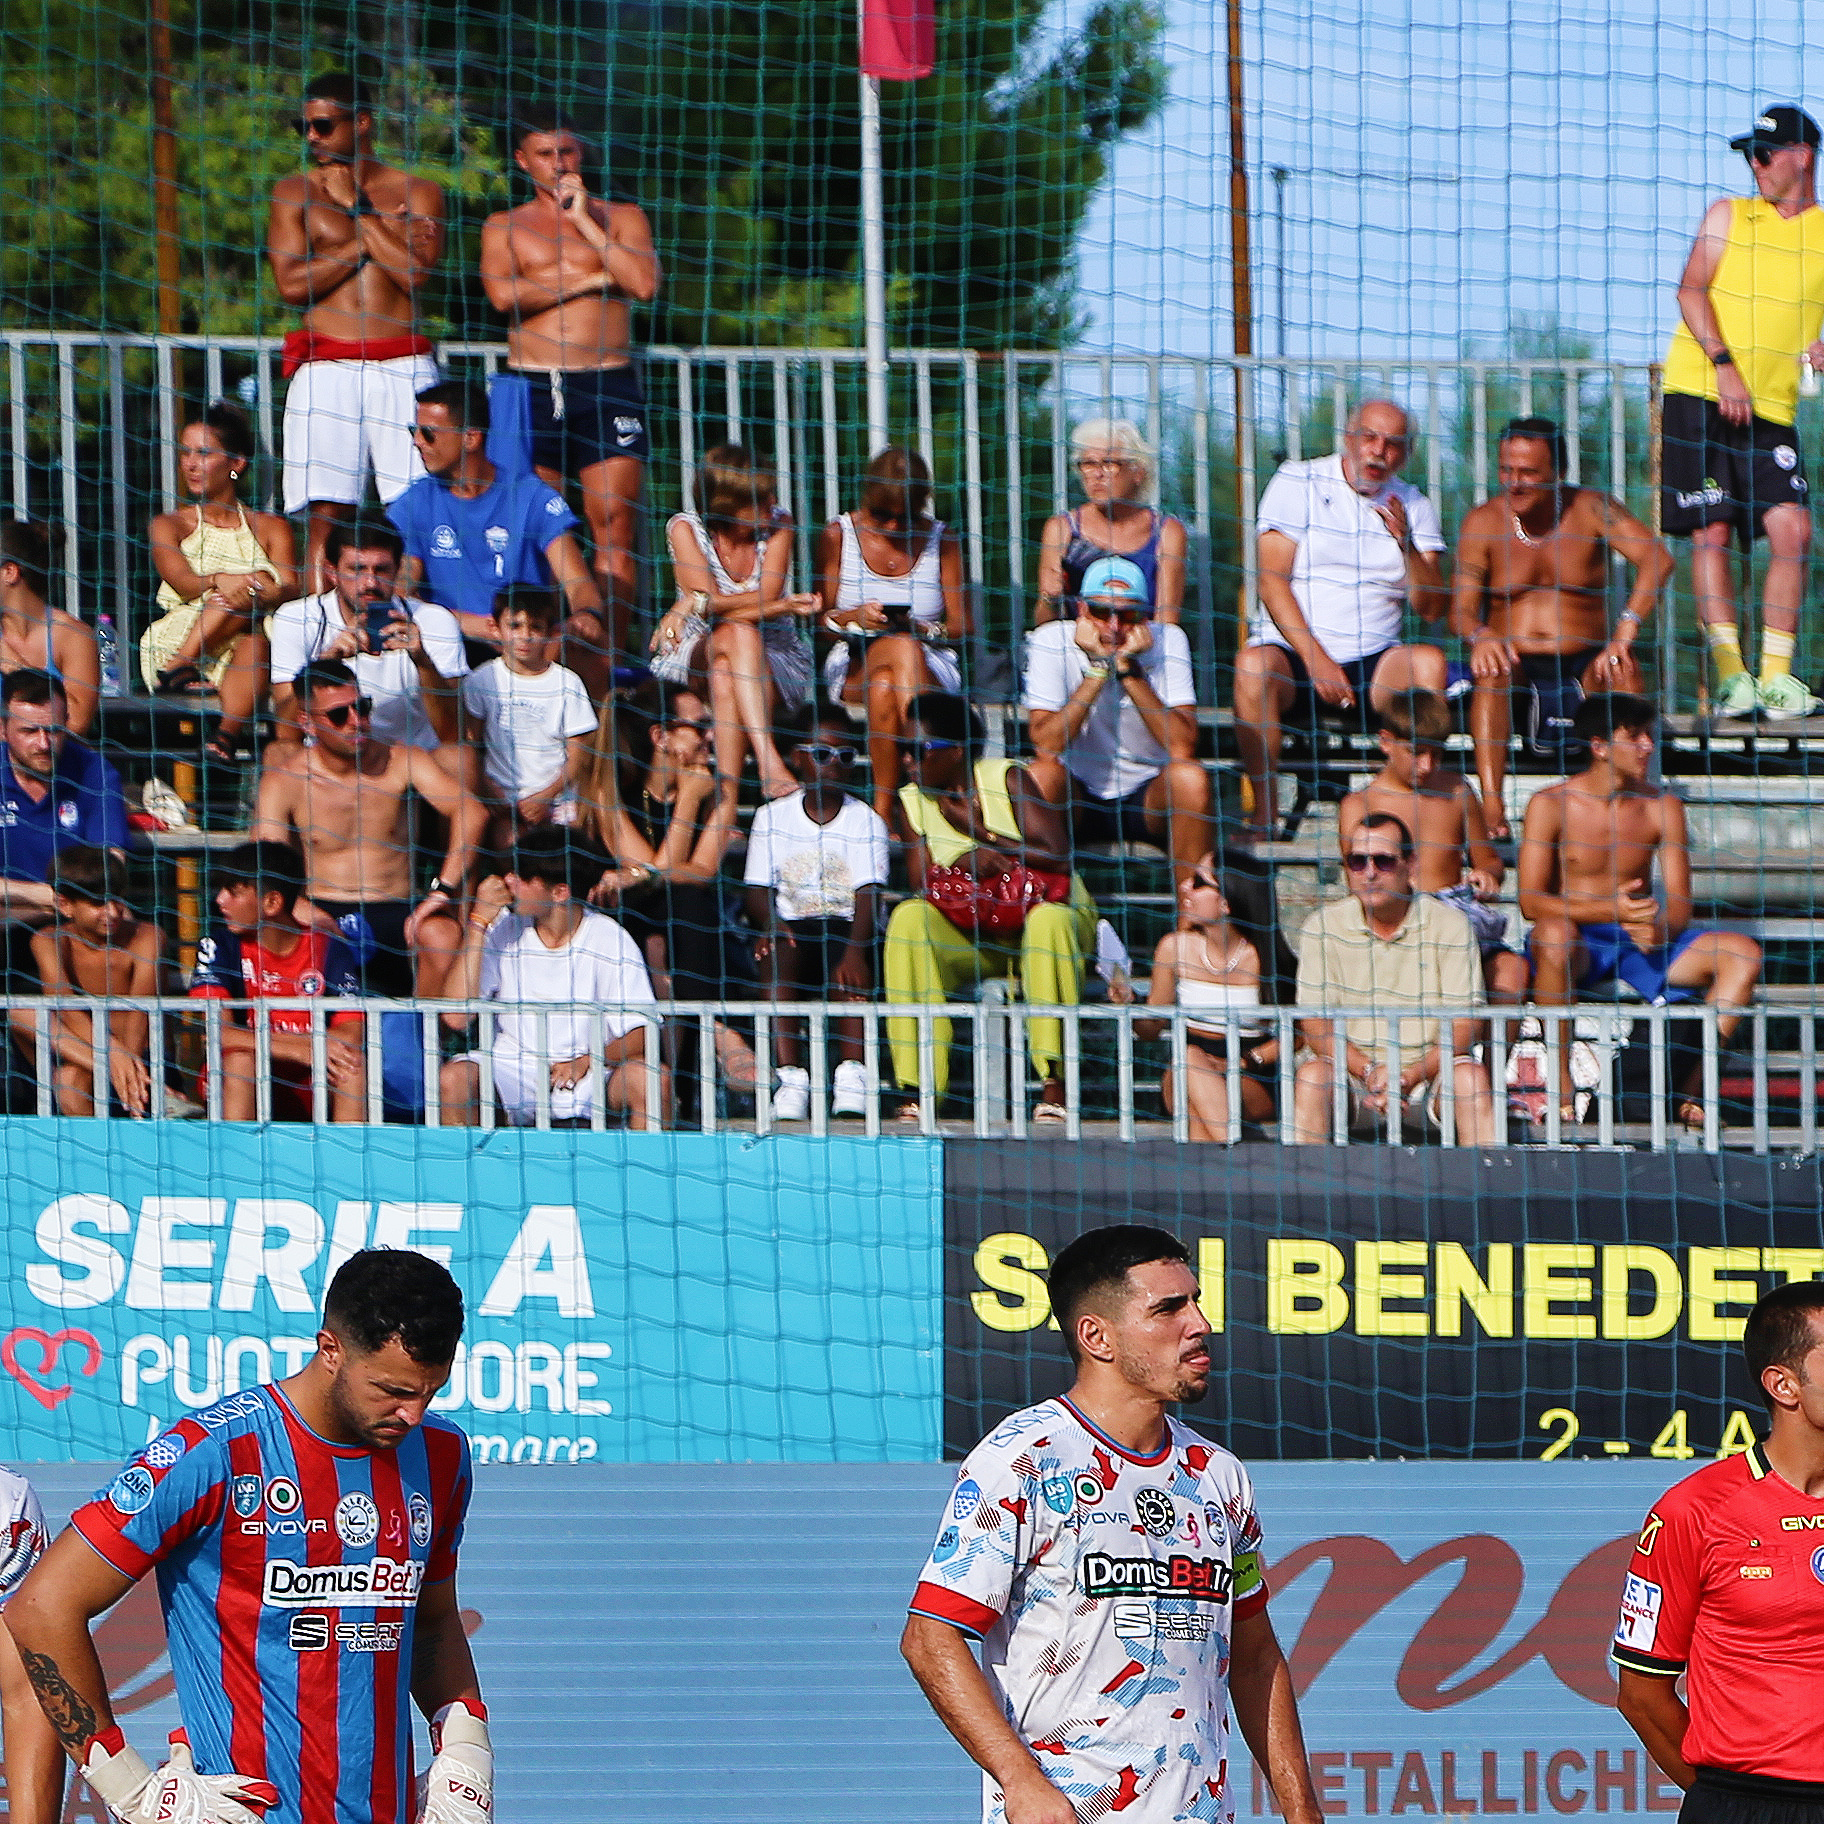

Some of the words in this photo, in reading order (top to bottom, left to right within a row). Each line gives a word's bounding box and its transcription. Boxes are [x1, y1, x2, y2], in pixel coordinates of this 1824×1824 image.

[479, 1204, 597, 1319] A
[121, 1336, 613, 1417] PUNTORE
[1539, 1408, 1578, 1460] 2
[1644, 1409, 1696, 1460] 4
[1251, 1749, 1685, 1816] ETALLICHE
